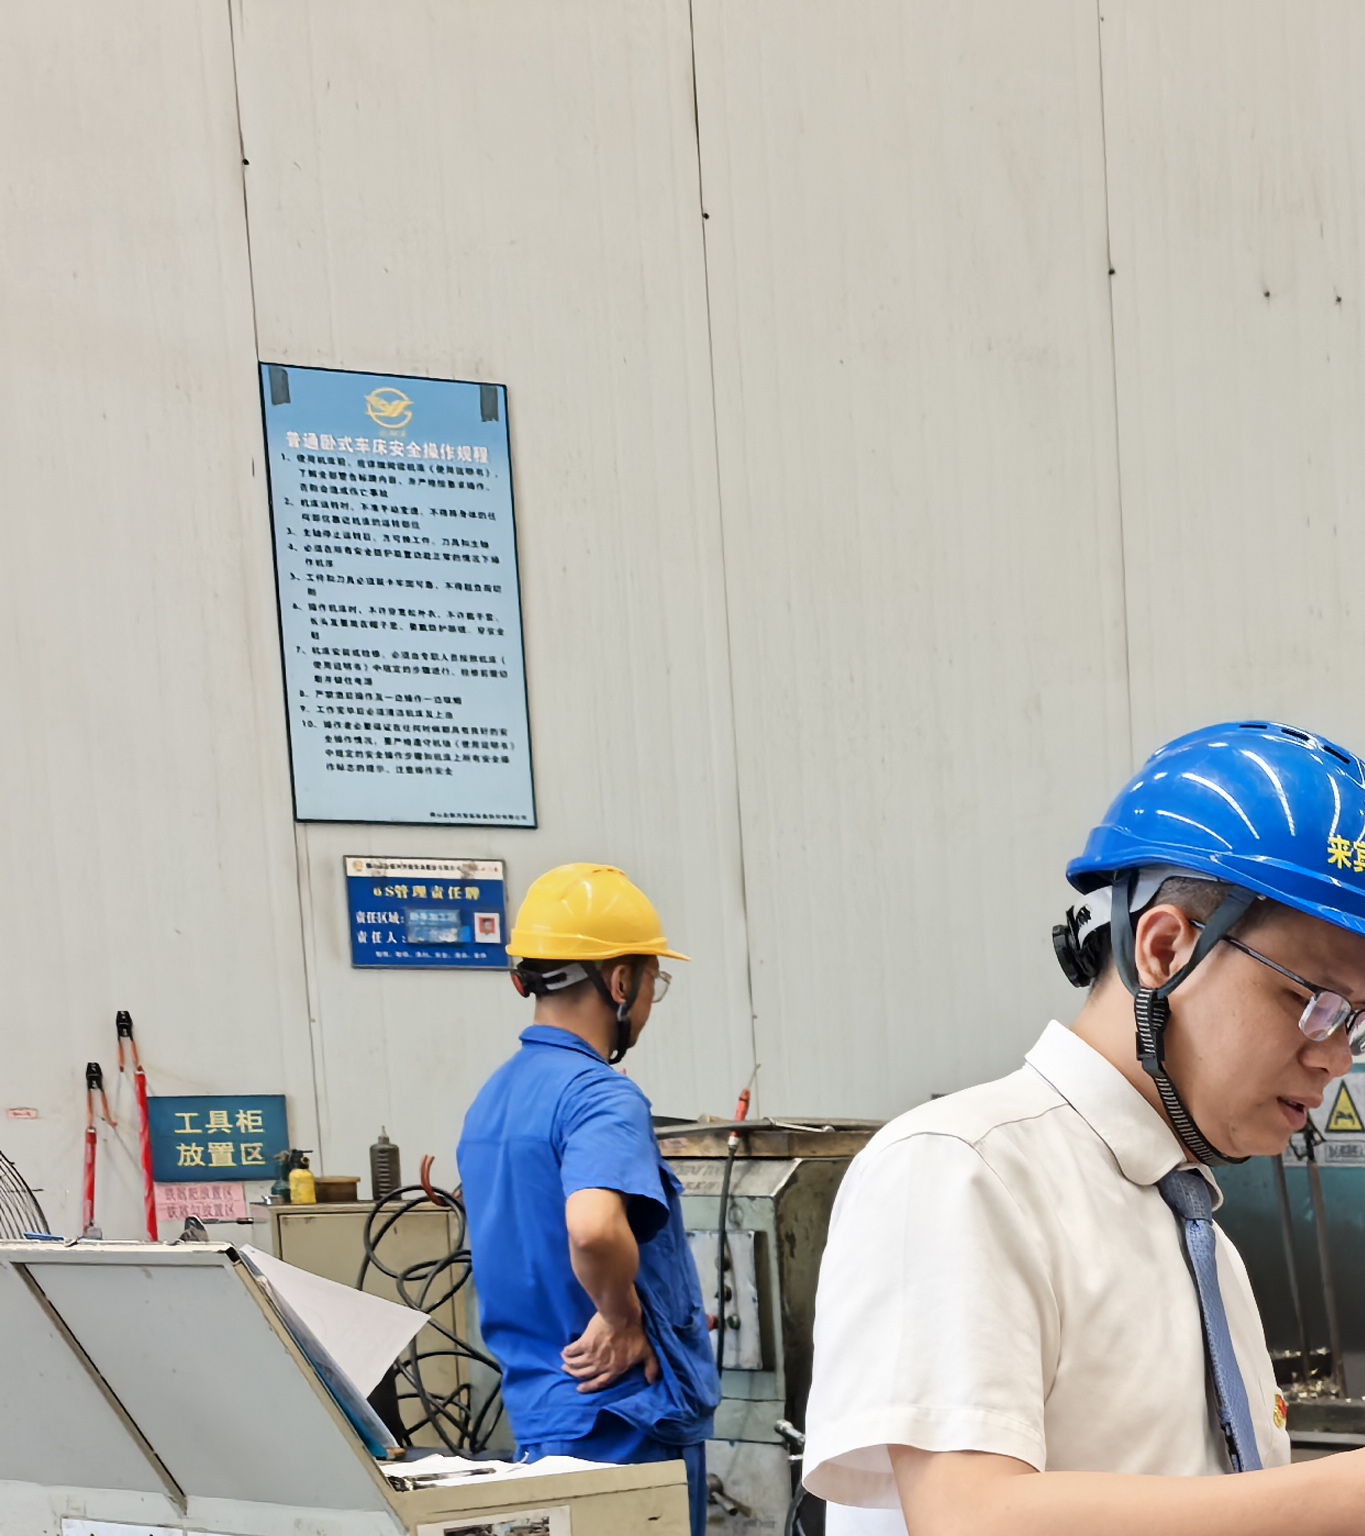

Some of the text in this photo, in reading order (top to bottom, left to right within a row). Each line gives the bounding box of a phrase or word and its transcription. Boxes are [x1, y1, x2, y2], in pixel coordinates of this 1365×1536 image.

[174, 1109, 265, 1135] 工具柜
[176, 1142, 267, 1168] 放置区
